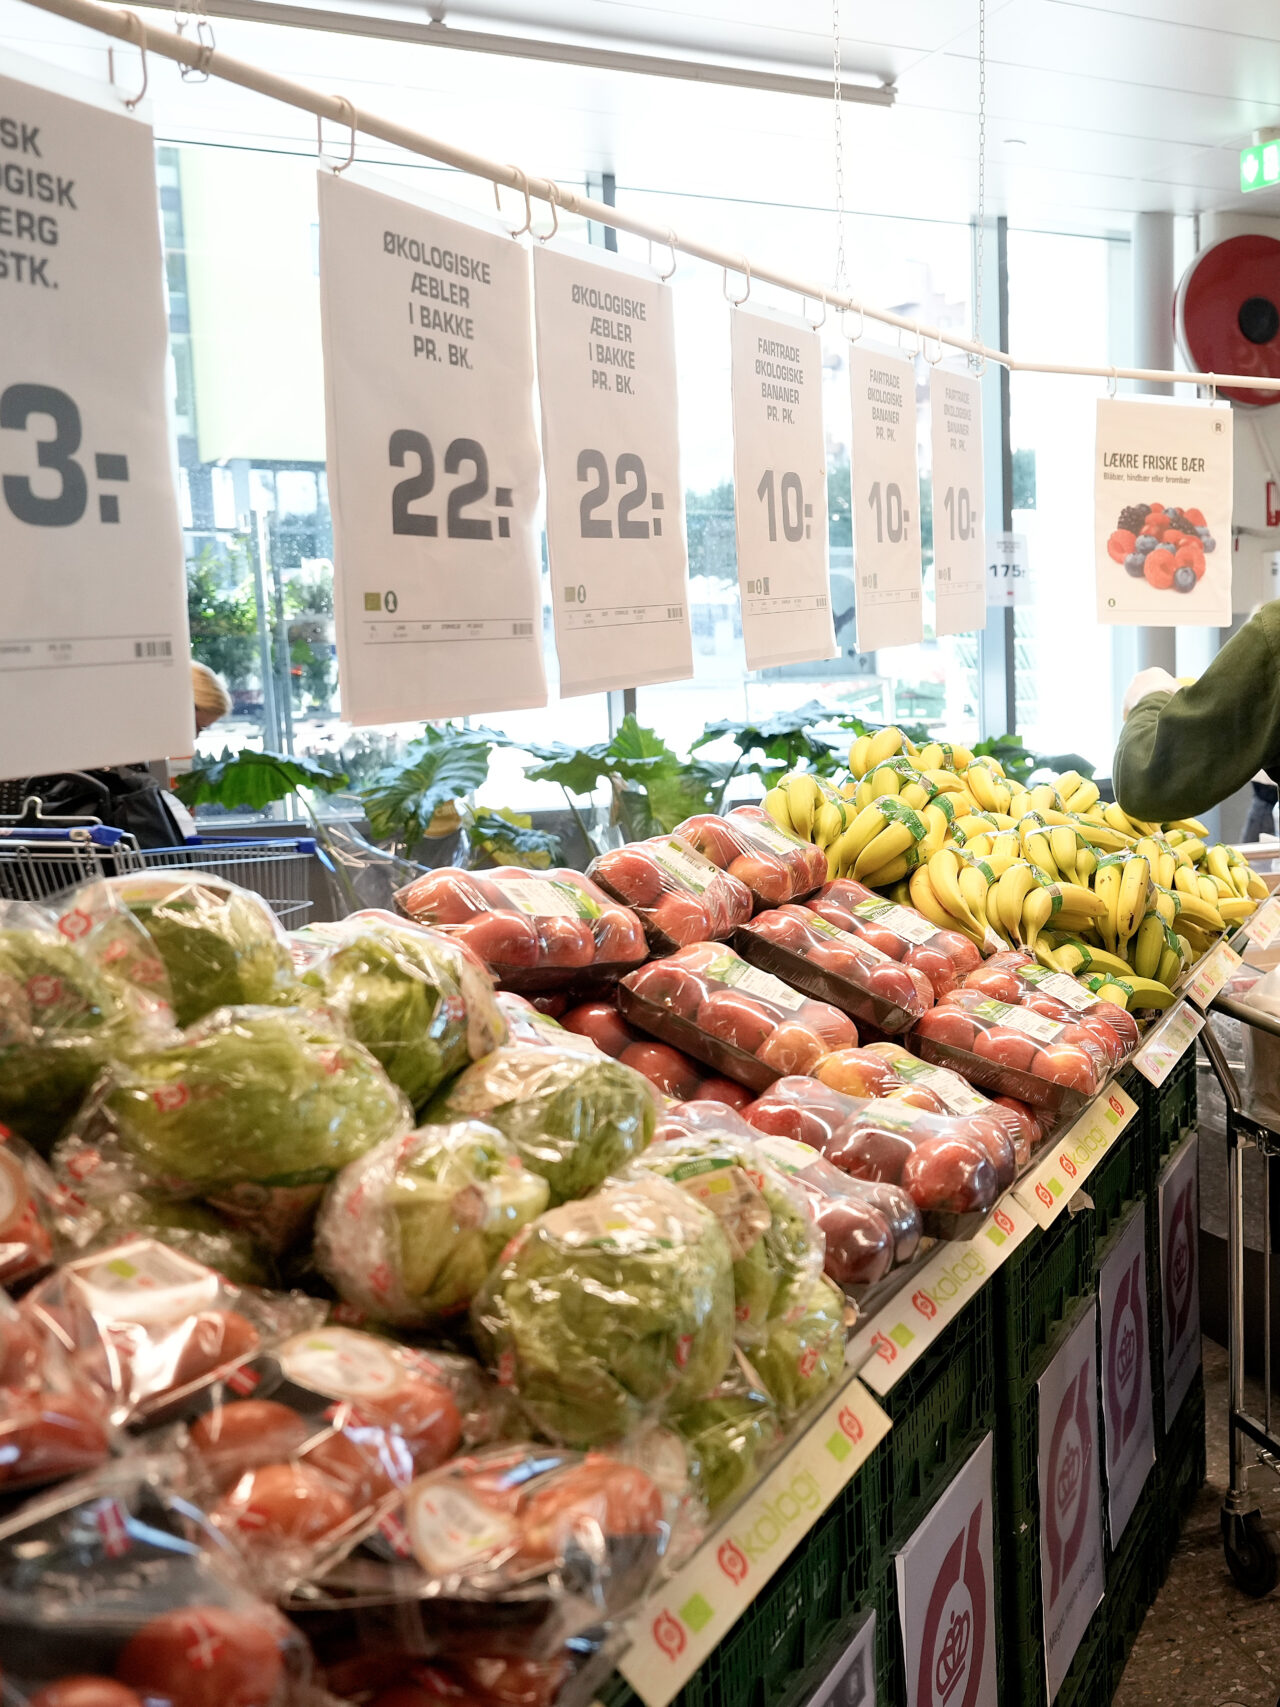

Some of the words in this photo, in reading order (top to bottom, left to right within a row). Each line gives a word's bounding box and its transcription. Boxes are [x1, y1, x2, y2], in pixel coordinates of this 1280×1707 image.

[0, 163, 77, 210] GISK
[383, 230, 491, 285] ØKOLOGISKE
[411, 271, 470, 309] ÆBLER
[571, 283, 647, 322] ØKOLOGISKE
[409, 301, 414, 325] I
[420, 305, 474, 340] BAKKE
[590, 316, 632, 344] ÆBLER
[413, 335, 442, 363] PR.
[448, 343, 473, 370] BK.
[588, 342, 593, 361] I
[596, 343, 636, 370] BAKKE
[757, 337, 800, 364] FAIRTRADE
[592, 369, 612, 391] PR.
[616, 374, 635, 396] BK.
[755, 359, 804, 385] ØKOLOGISKE
[869, 368, 900, 390] FAIRTRADE
[761, 382, 800, 405] BANANER
[867, 387, 903, 408] ØKOLOGISKE
[767, 405, 780, 423] PR.
[782, 408, 795, 425] PK.
[872, 406, 900, 425] BANANER
[1103, 452, 1139, 469] LÆKRE
[1142, 454, 1178, 471] FRISKE
[1181, 456, 1205, 472] BÆR
